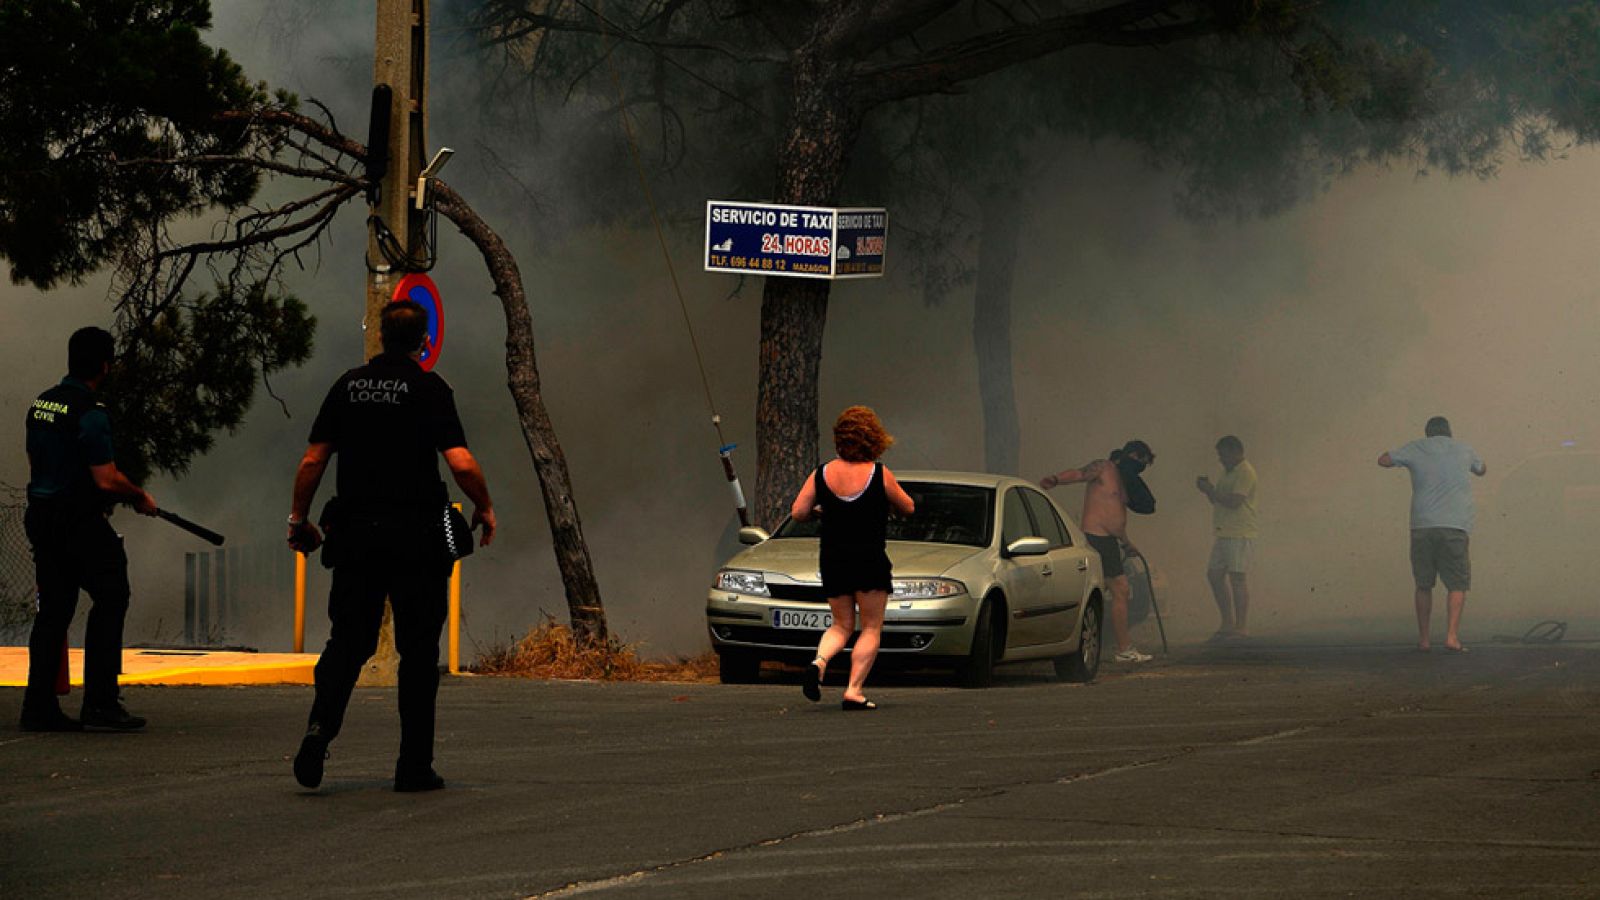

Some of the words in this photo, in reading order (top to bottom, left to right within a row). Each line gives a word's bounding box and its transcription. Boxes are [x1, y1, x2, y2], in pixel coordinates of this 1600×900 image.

[712, 208, 776, 226] SERVICIO
[780, 212, 798, 228] DE
[802, 213, 832, 230] TAXI
[784, 235, 831, 257] HORAS
[749, 257, 760, 269] 44
[762, 259, 773, 270] 88
[775, 259, 786, 271] 12
[348, 378, 409, 393] POLICÍA
[350, 391, 401, 405] LOCAL
[33, 410, 55, 423] CIVIL
[782, 612, 819, 627] 0042
